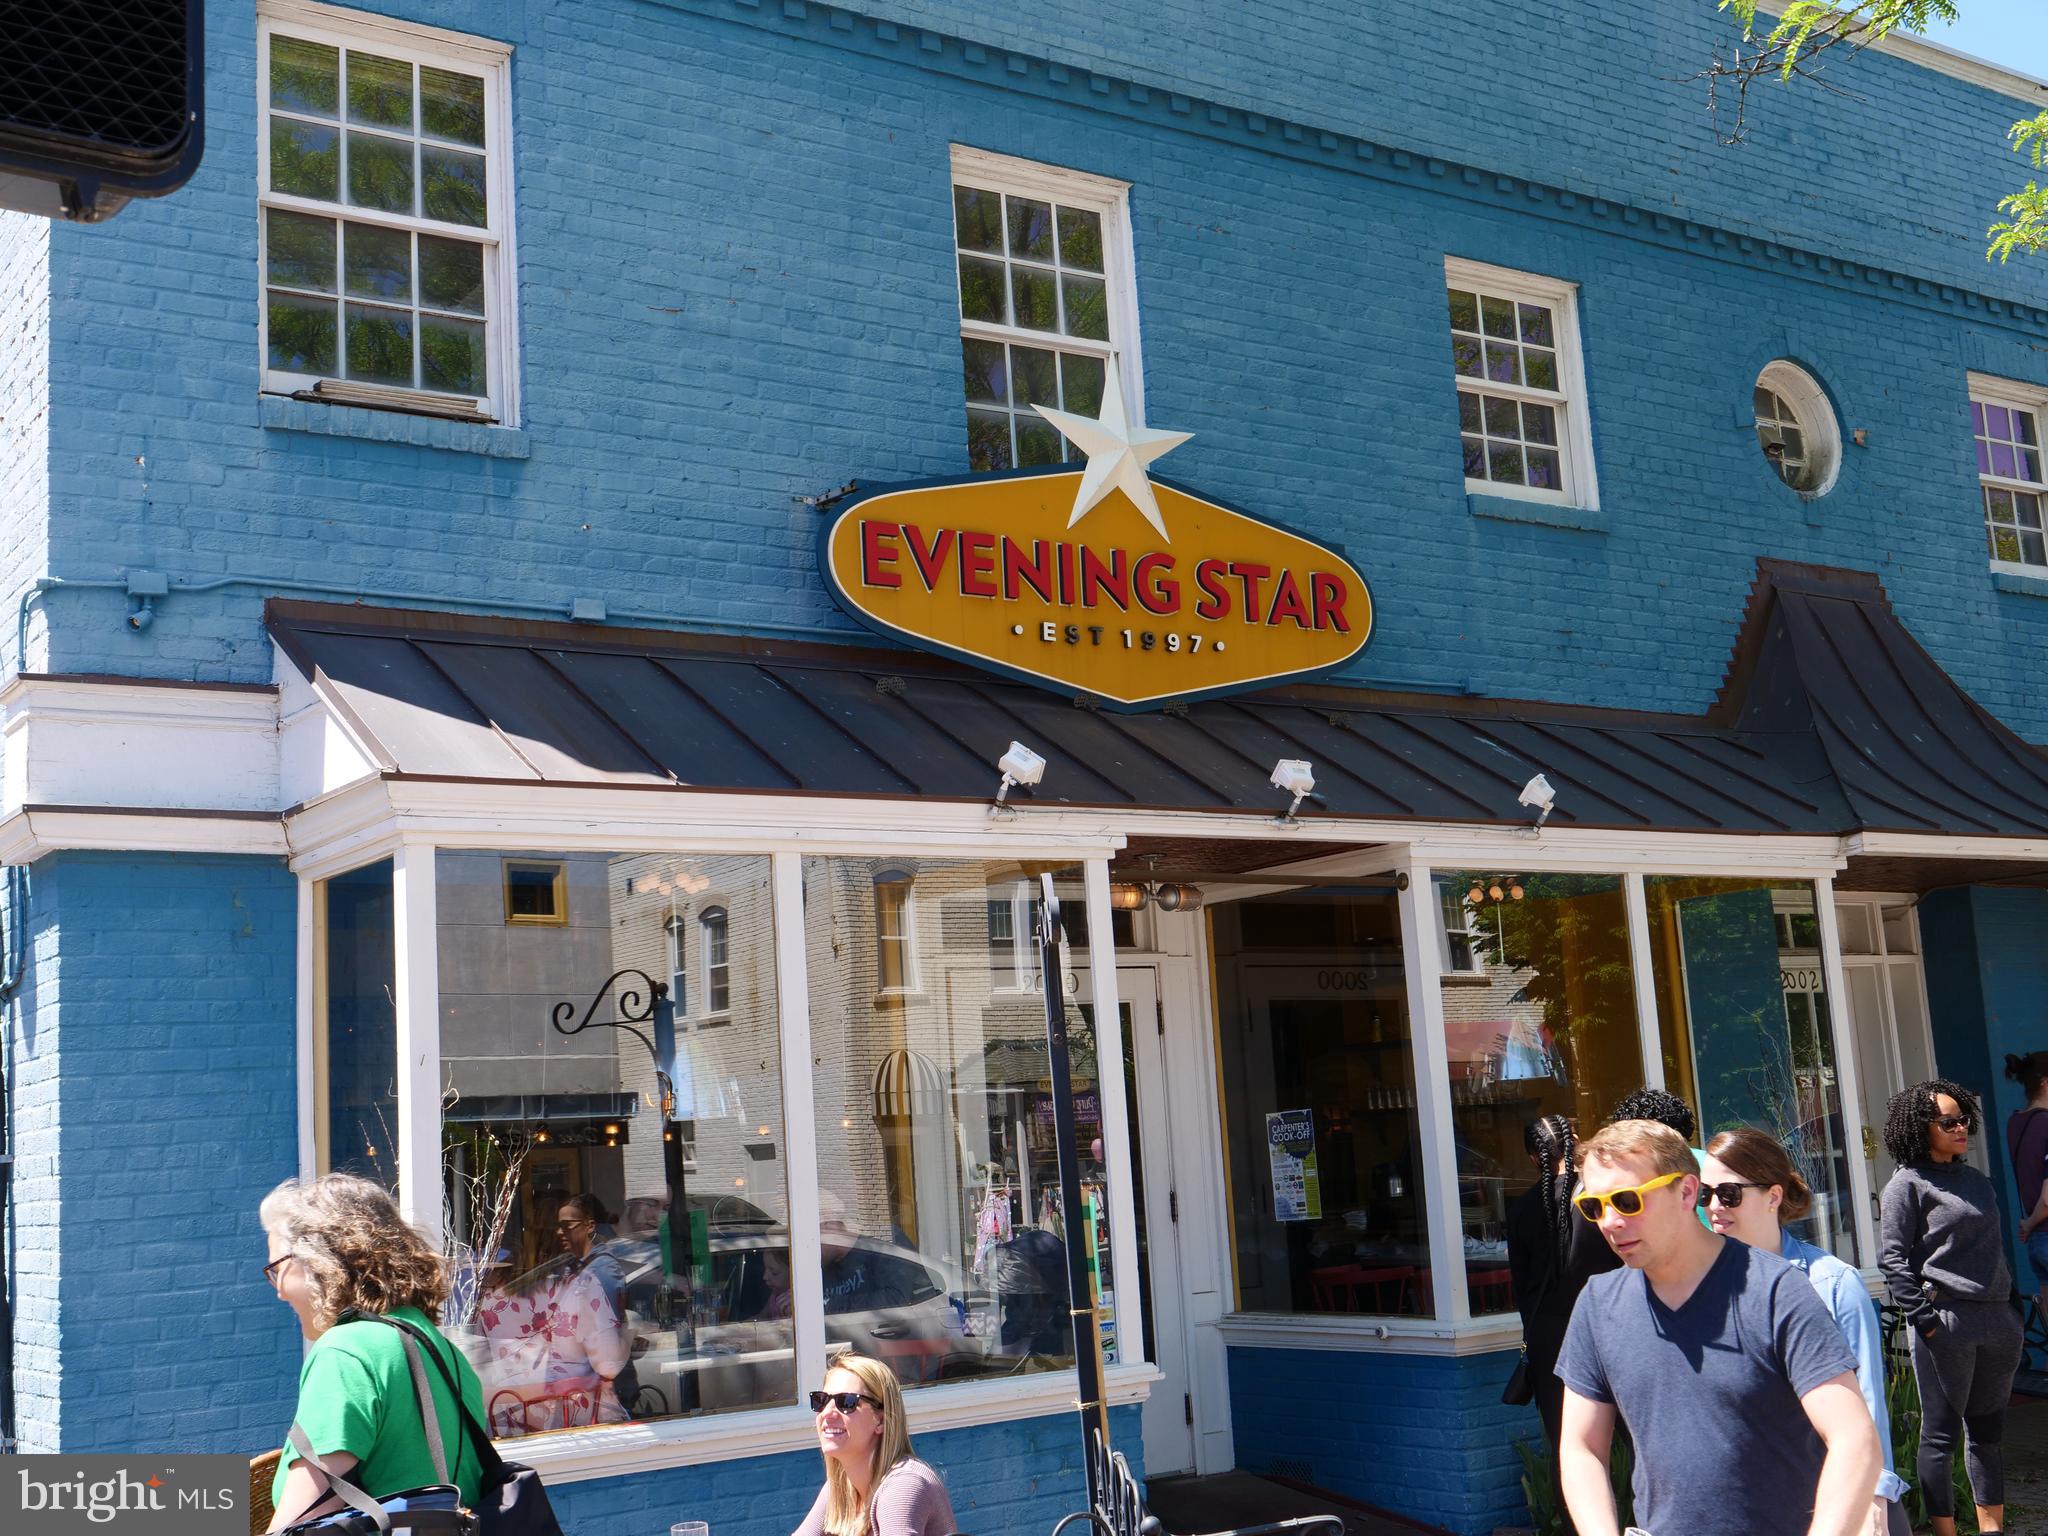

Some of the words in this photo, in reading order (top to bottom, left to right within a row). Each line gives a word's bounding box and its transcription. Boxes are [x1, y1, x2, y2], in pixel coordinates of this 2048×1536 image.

[859, 520, 1181, 616] EVENING
[1195, 558, 1351, 634] STAR
[1040, 621, 1104, 646] EST
[1121, 629, 1203, 654] 1997
[1272, 1131, 1311, 1142] COOK-OFF
